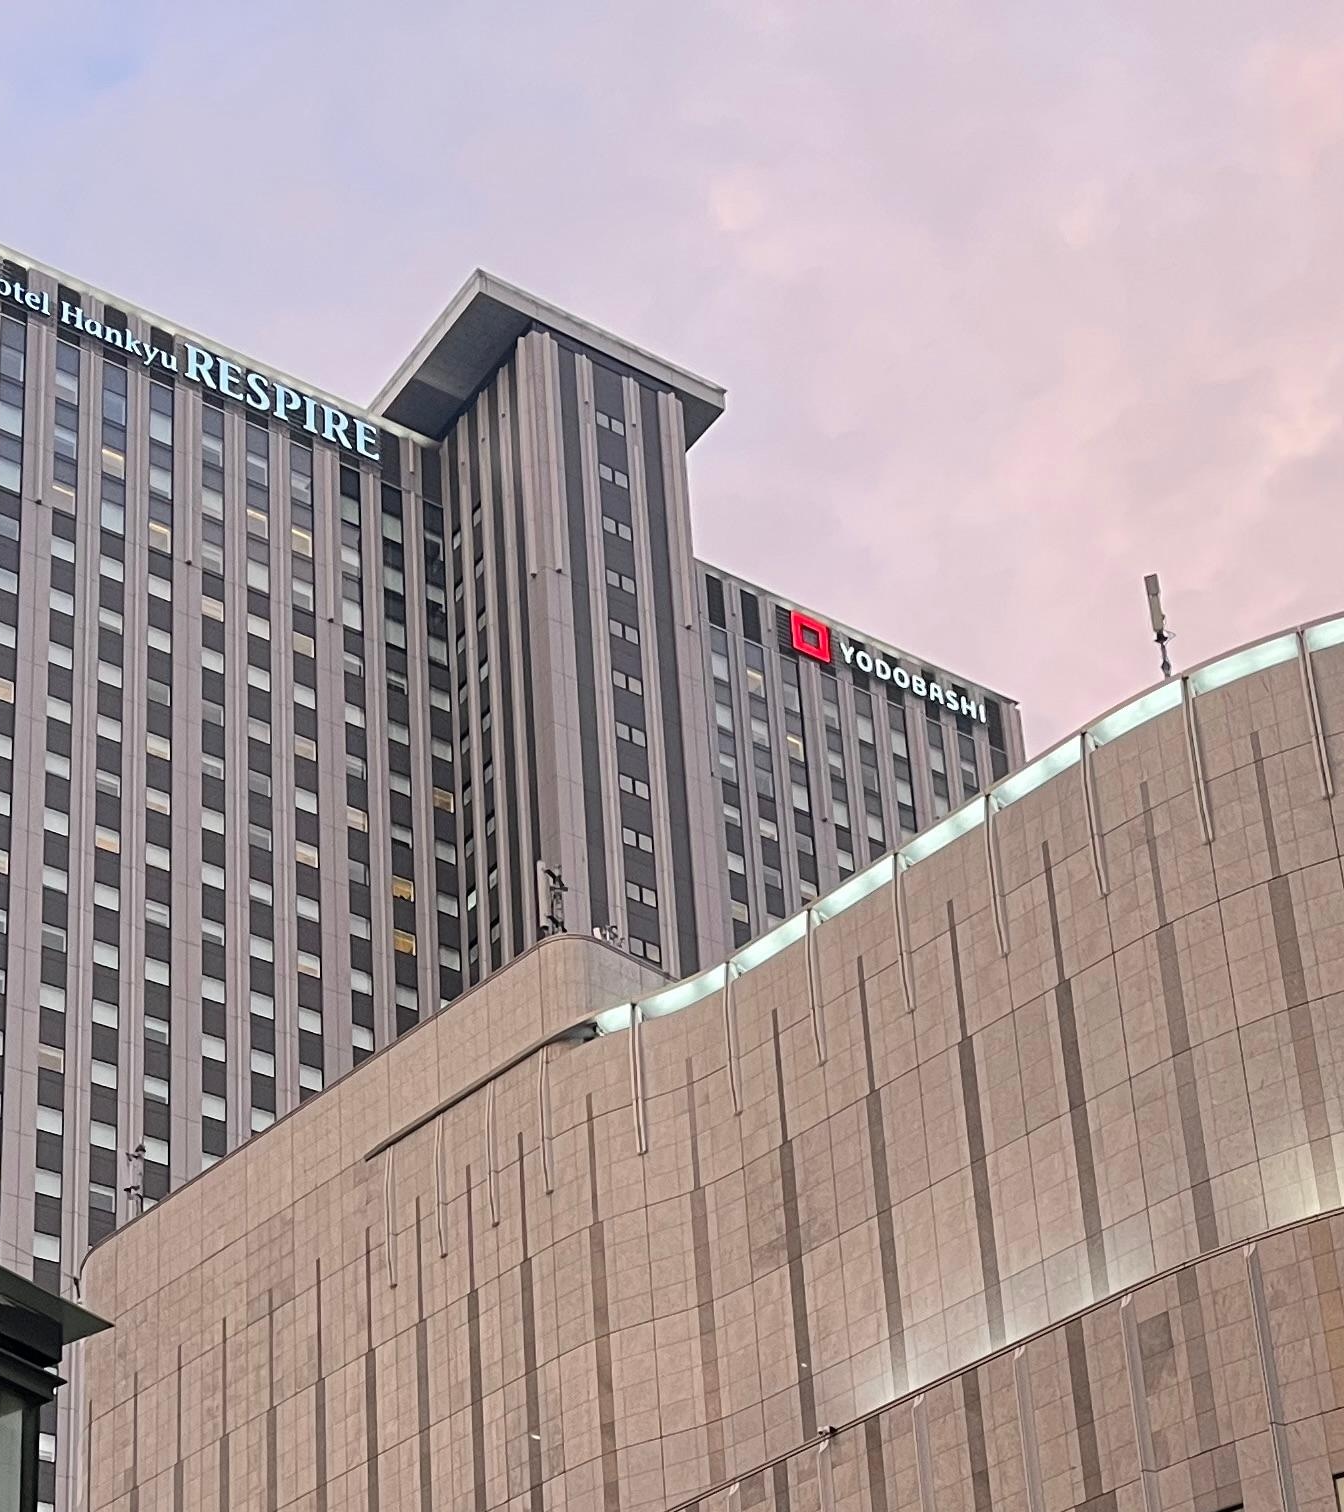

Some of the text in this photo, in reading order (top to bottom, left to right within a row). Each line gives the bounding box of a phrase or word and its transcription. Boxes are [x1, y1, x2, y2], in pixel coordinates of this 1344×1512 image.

[59, 301, 179, 373] Hankyu
[183, 342, 382, 461] RESPIRE
[839, 642, 987, 723] YODOBASHI
